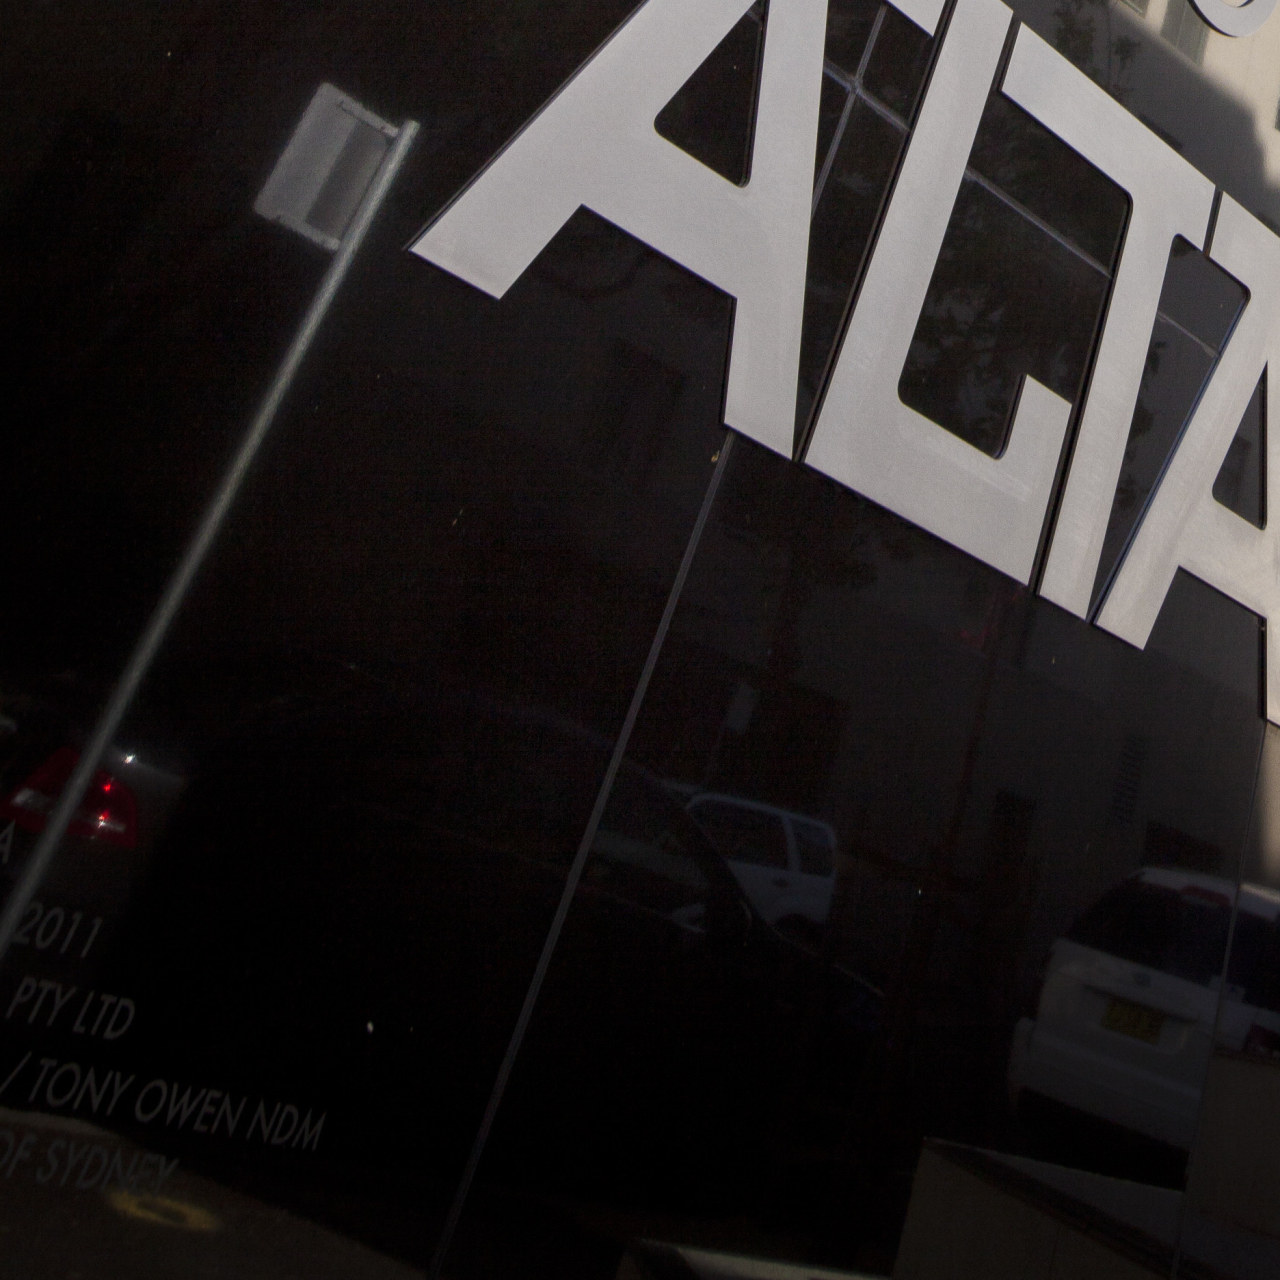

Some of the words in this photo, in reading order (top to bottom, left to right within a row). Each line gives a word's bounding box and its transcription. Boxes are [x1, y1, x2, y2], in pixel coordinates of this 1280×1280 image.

[14, 902, 103, 958] 2011
[5, 976, 79, 1027] PTY
[74, 989, 137, 1041] LTD
[27, 1057, 137, 1117] TONY
[134, 1078, 249, 1139] OWEN
[246, 1100, 327, 1152] NDM
[35, 1138, 182, 1196] SYDNEY
